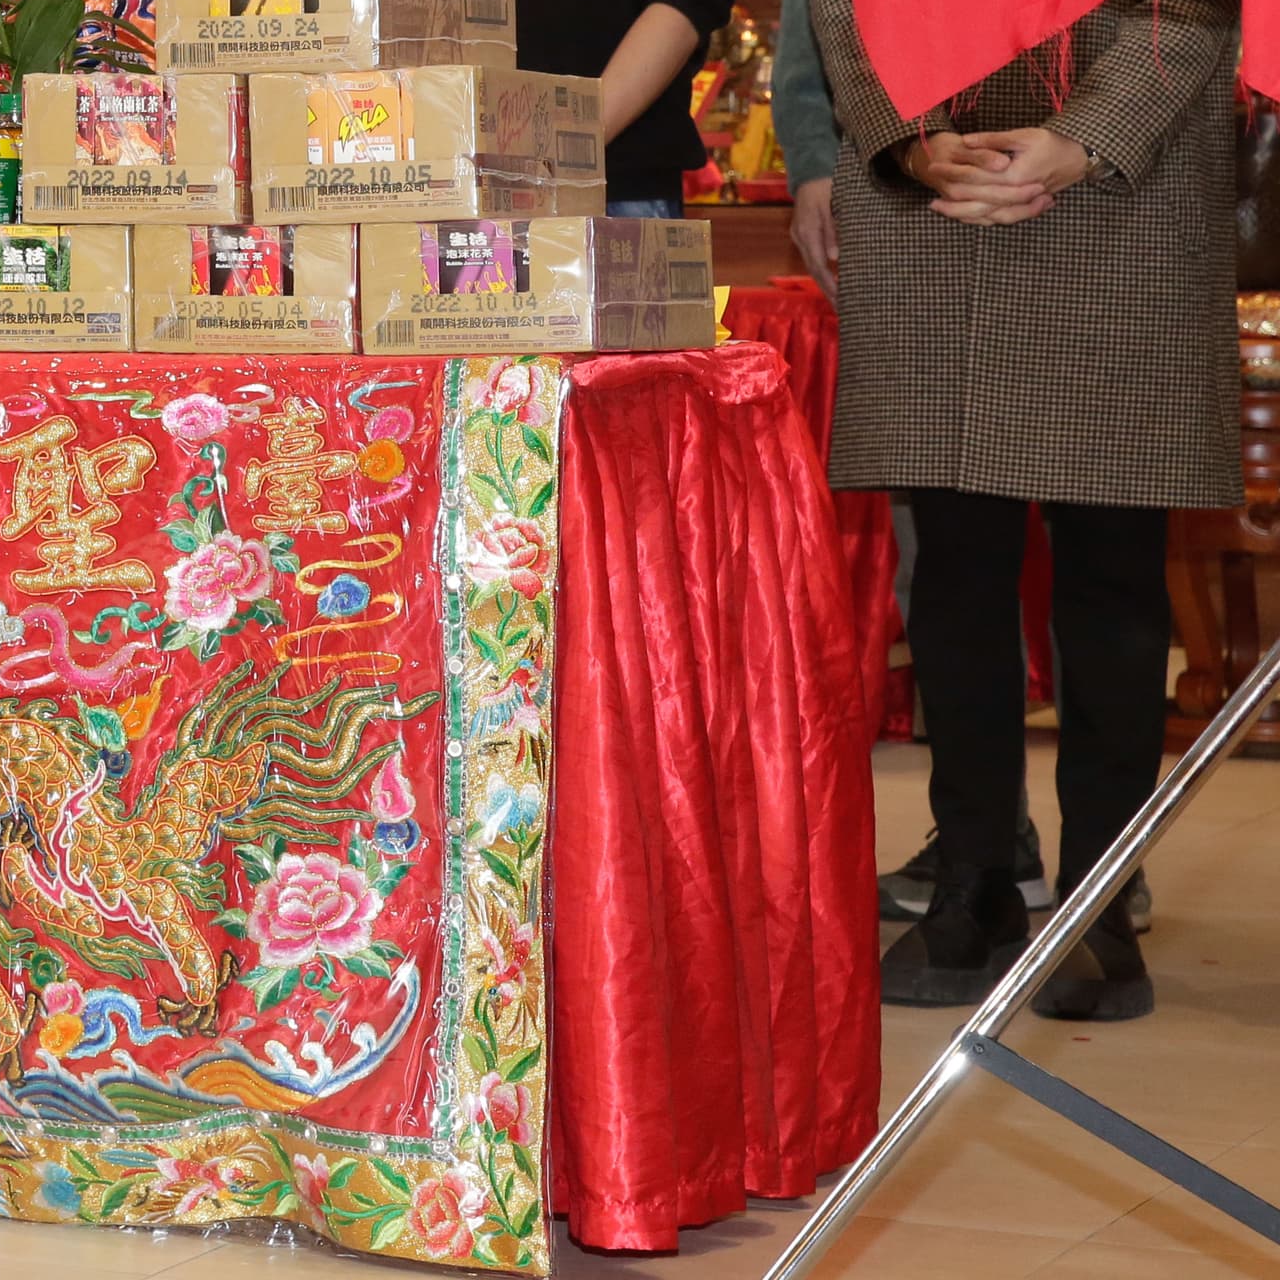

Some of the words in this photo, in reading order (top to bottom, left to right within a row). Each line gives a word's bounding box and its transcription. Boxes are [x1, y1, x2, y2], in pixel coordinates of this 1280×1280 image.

[198, 19, 319, 38] 2022.09.24
[218, 41, 322, 54] 順開科技股份有限公司
[449, 232, 488, 246] 生活
[410, 293, 537, 314] 2022.10.04
[420, 316, 545, 330] 順開科技股份有限公司
